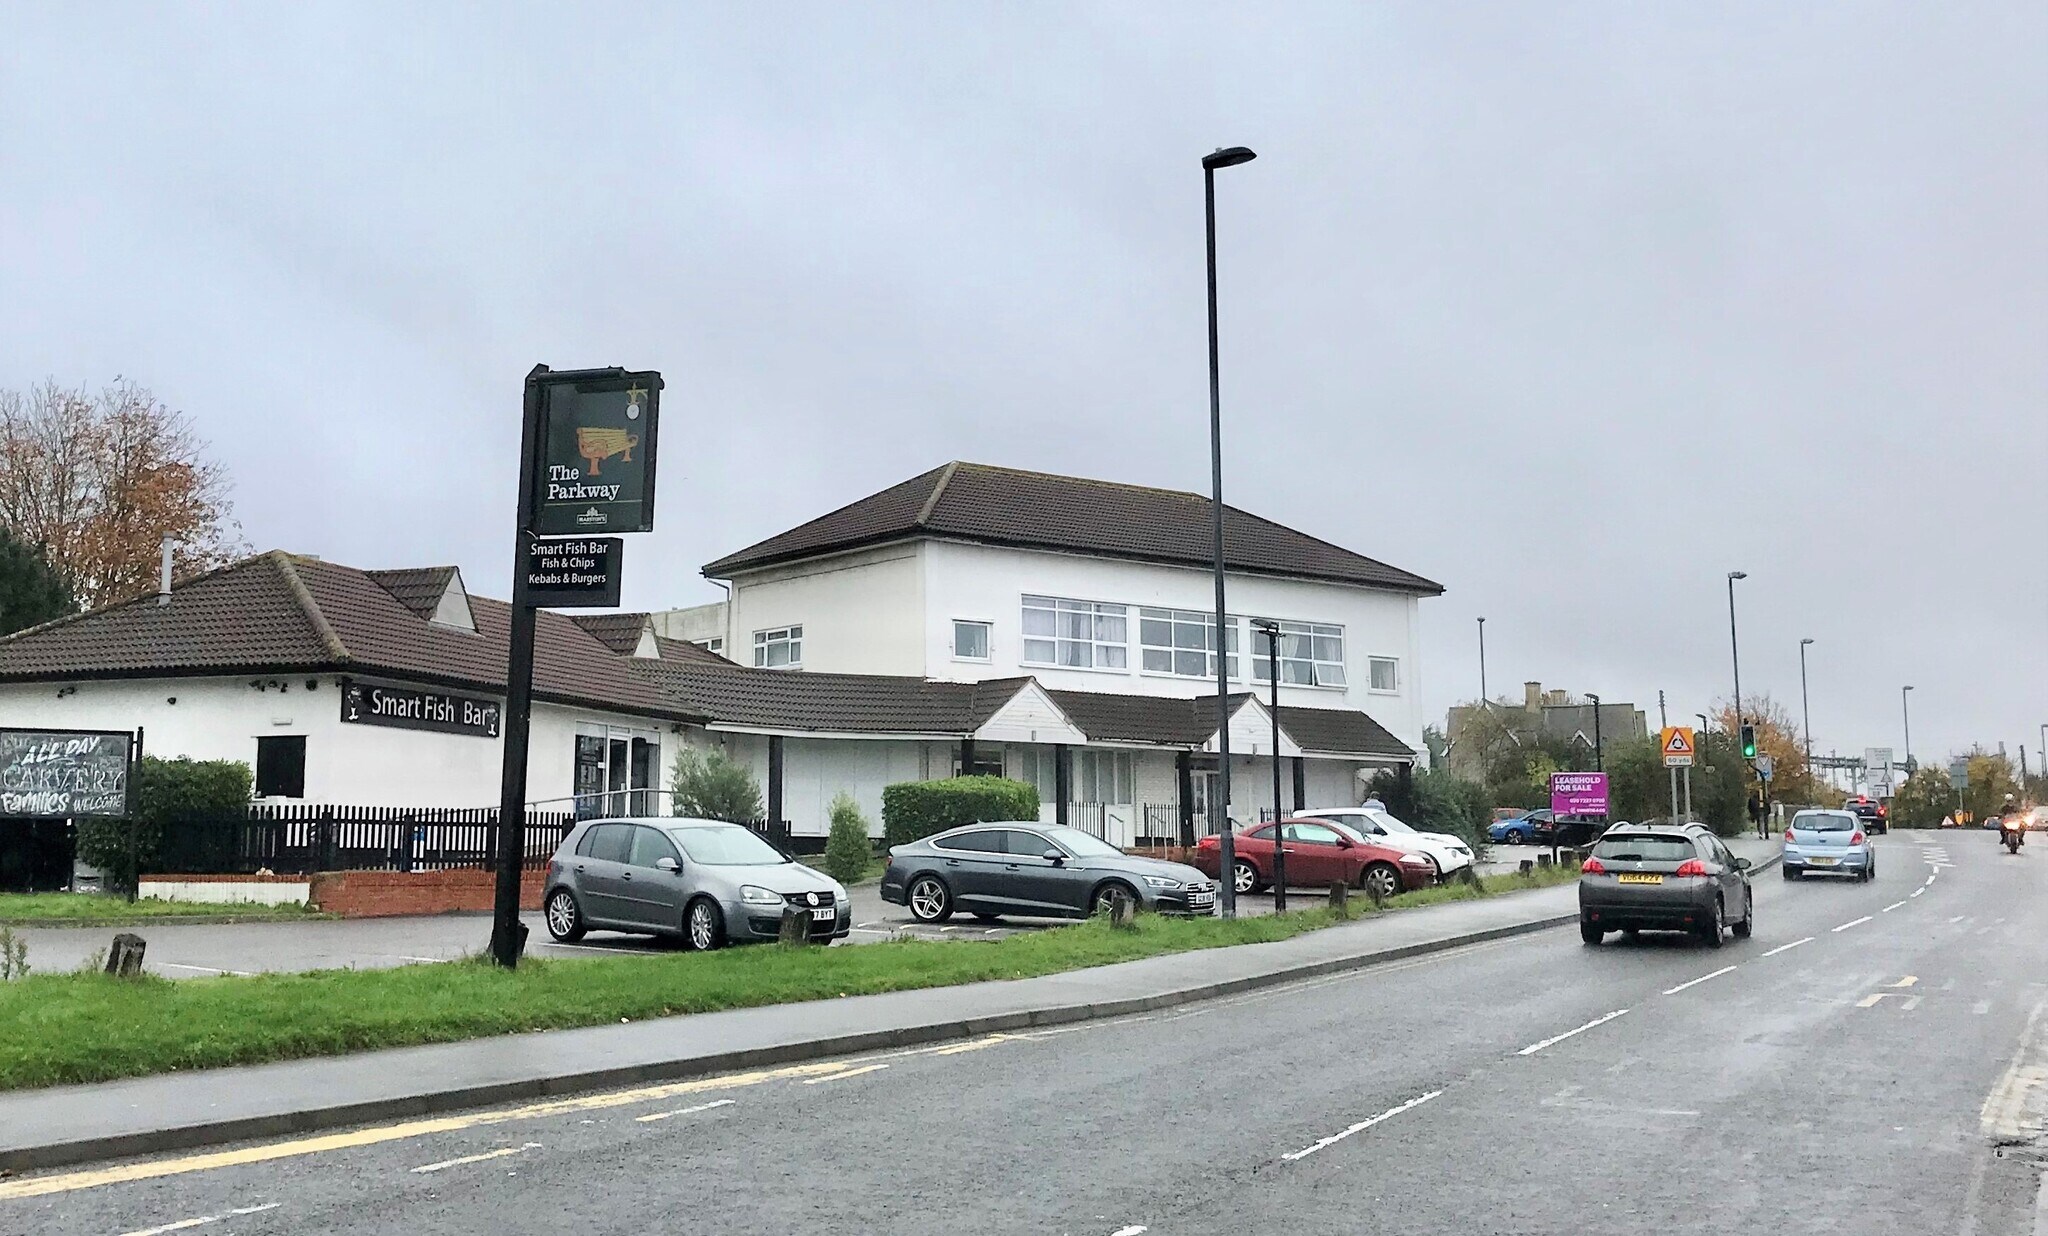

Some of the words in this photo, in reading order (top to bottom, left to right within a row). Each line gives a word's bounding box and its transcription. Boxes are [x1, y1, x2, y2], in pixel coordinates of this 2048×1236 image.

[549, 465, 579, 481] The
[547, 483, 621, 501] Parkway
[530, 543, 563, 555] Smart
[565, 542, 587, 554] Fish
[589, 542, 608, 554] Bar
[541, 558, 559, 568] Fish
[561, 558, 568, 567] &
[569, 557, 595, 570] Chips
[528, 573, 561, 584] Kebabs
[563, 574, 570, 583] &
[571, 573, 606, 586] Burgers
[371, 689, 421, 719] Smart
[424, 695, 455, 722] Fish
[463, 701, 488, 726] Bar
[21, 744, 60, 766] ALL
[64, 736, 100, 758] DAY
[3, 766, 124, 793] CARVERY
[73, 794, 123, 812] WELCOME
